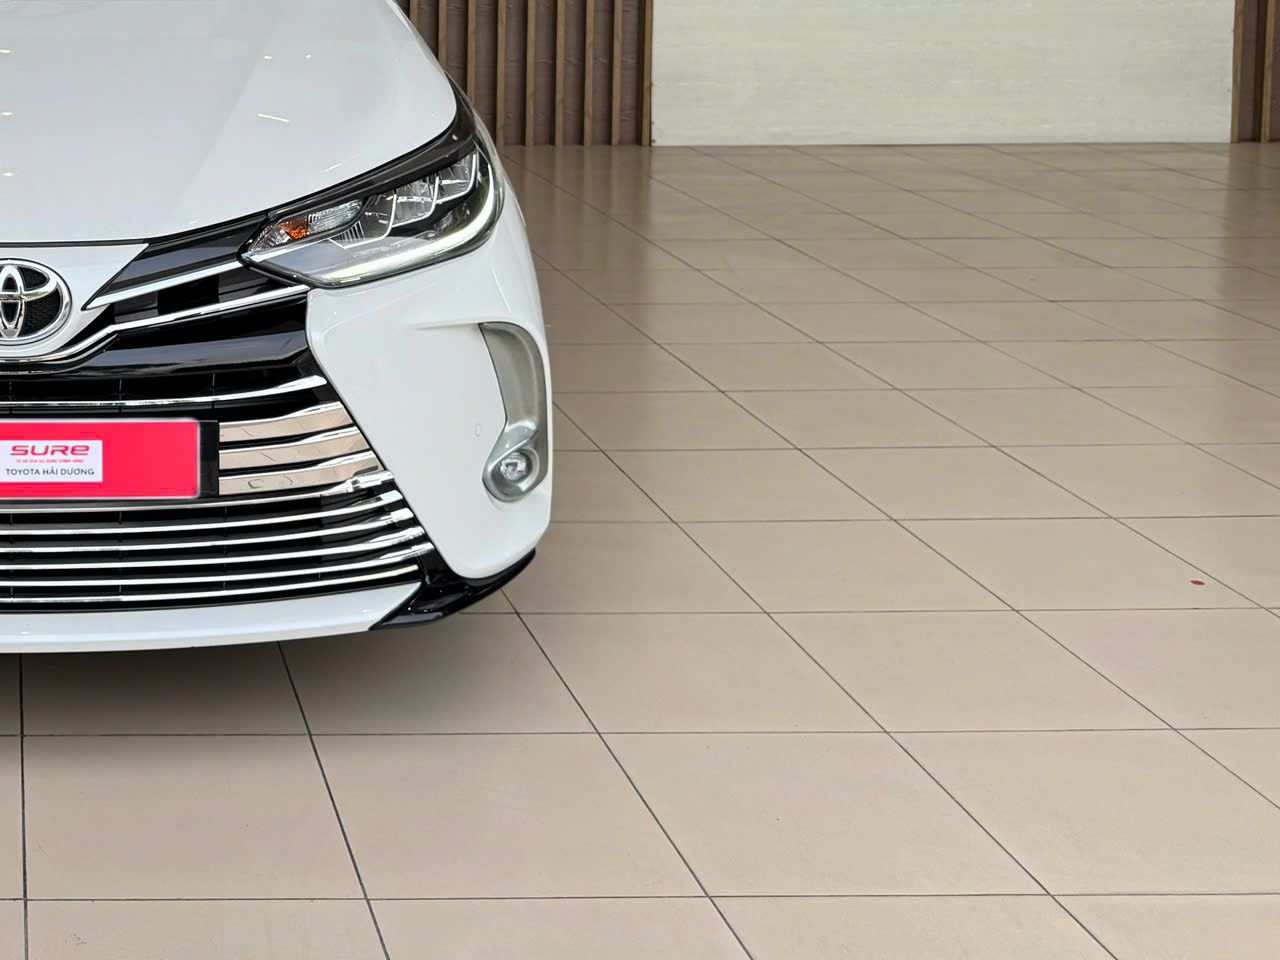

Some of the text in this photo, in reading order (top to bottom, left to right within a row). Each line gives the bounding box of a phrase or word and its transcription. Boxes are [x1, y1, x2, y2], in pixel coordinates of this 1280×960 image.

[6, 465, 95, 476] TOYOTA HẢI DƯƠNG
